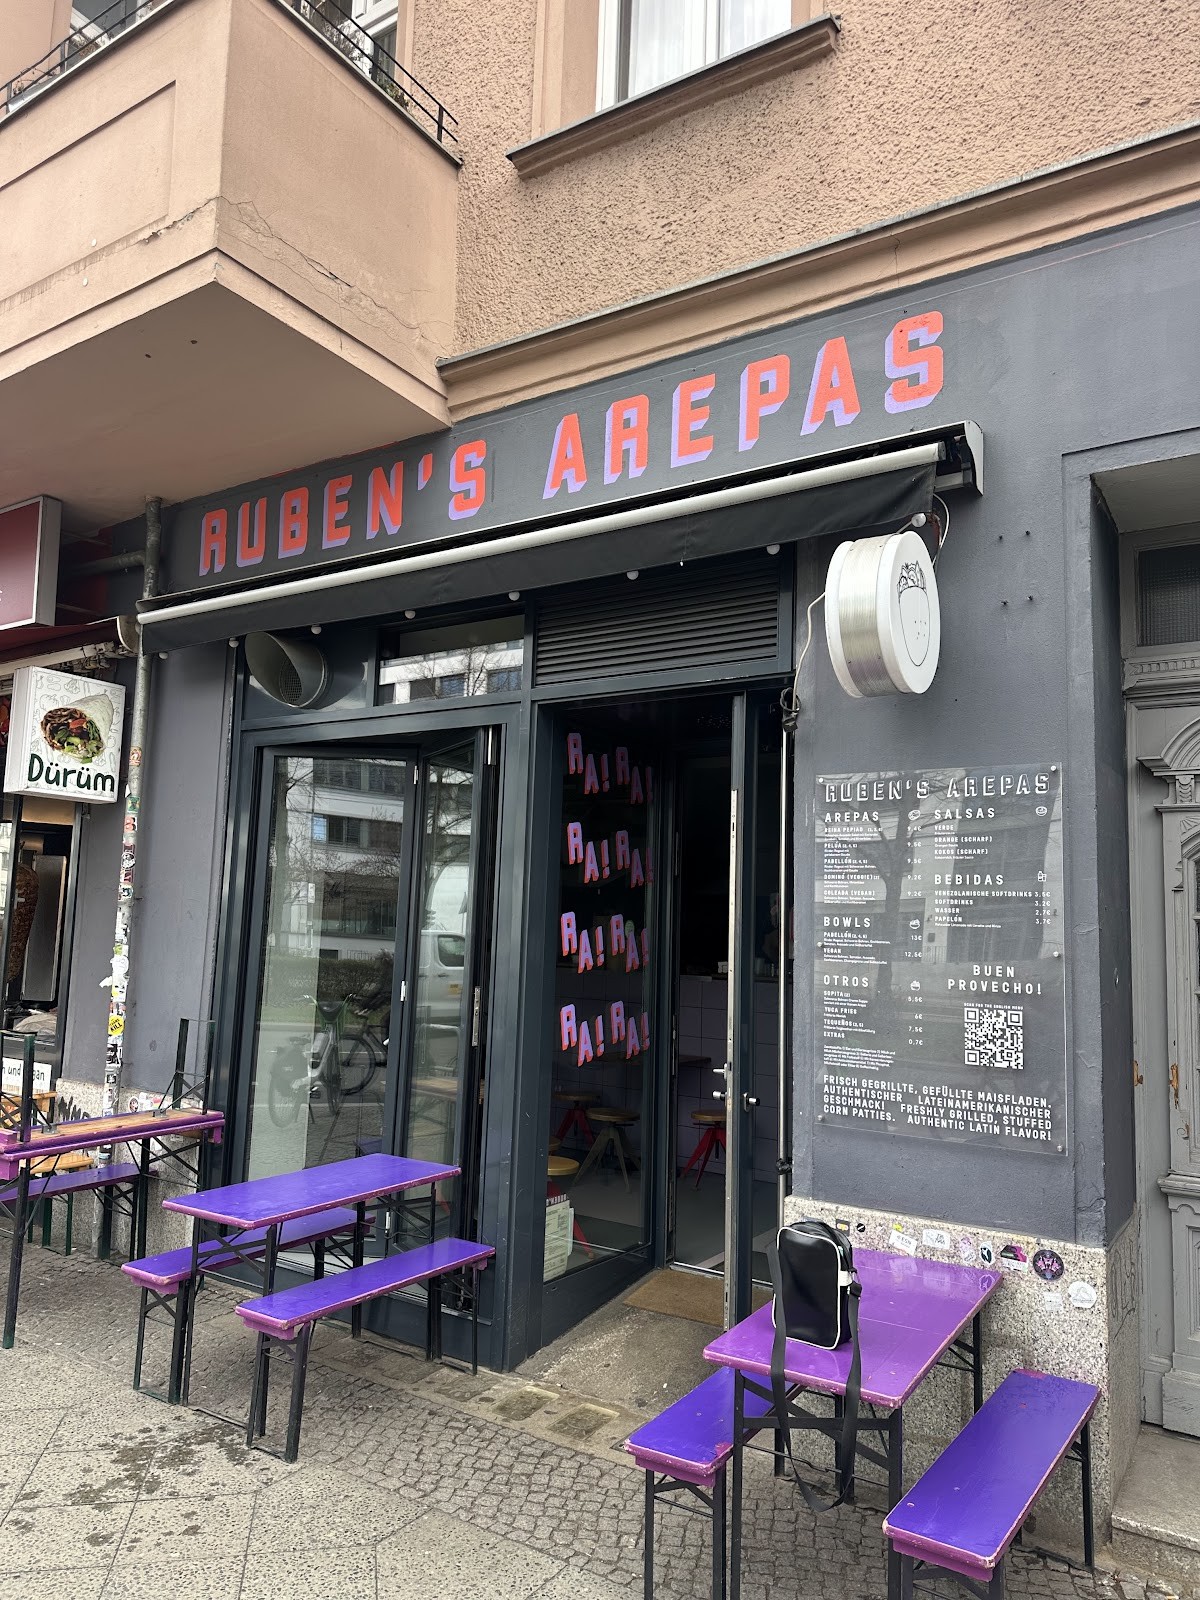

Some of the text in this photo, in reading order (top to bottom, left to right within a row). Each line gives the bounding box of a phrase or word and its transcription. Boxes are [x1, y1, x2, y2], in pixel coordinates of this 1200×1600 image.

[199, 310, 944, 577] RUBEN'S AREPAS
[27, 753, 116, 793] Dürüm
[825, 773, 1050, 802] RUBEN'S AREPAS
[825, 811, 879, 823] AREPAS
[934, 807, 995, 819] SALSAS
[934, 874, 1004, 885] BEBIDAS
[823, 916, 871, 928] BOWLS
[973, 964, 1015, 978] BUEN
[823, 975, 869, 987] OTROS
[948, 979, 1041, 995] PROVECHO!
[7, 1063, 21, 1076] und
[824, 1075, 1052, 1108] FRISCH GEGRILLTE, GEFÜLLTE MAISFLADEN.
[824, 1085, 1051, 1119] AUTHENTISCHER LATEINAMERIKANISCHER
[824, 1095, 1052, 1130] GESCHMACK! FRESHLY GRILLED, STUFFED
[824, 1105, 1052, 1140] CORN PATTIES. AUTHENTIC LATIN FLAVOR!
